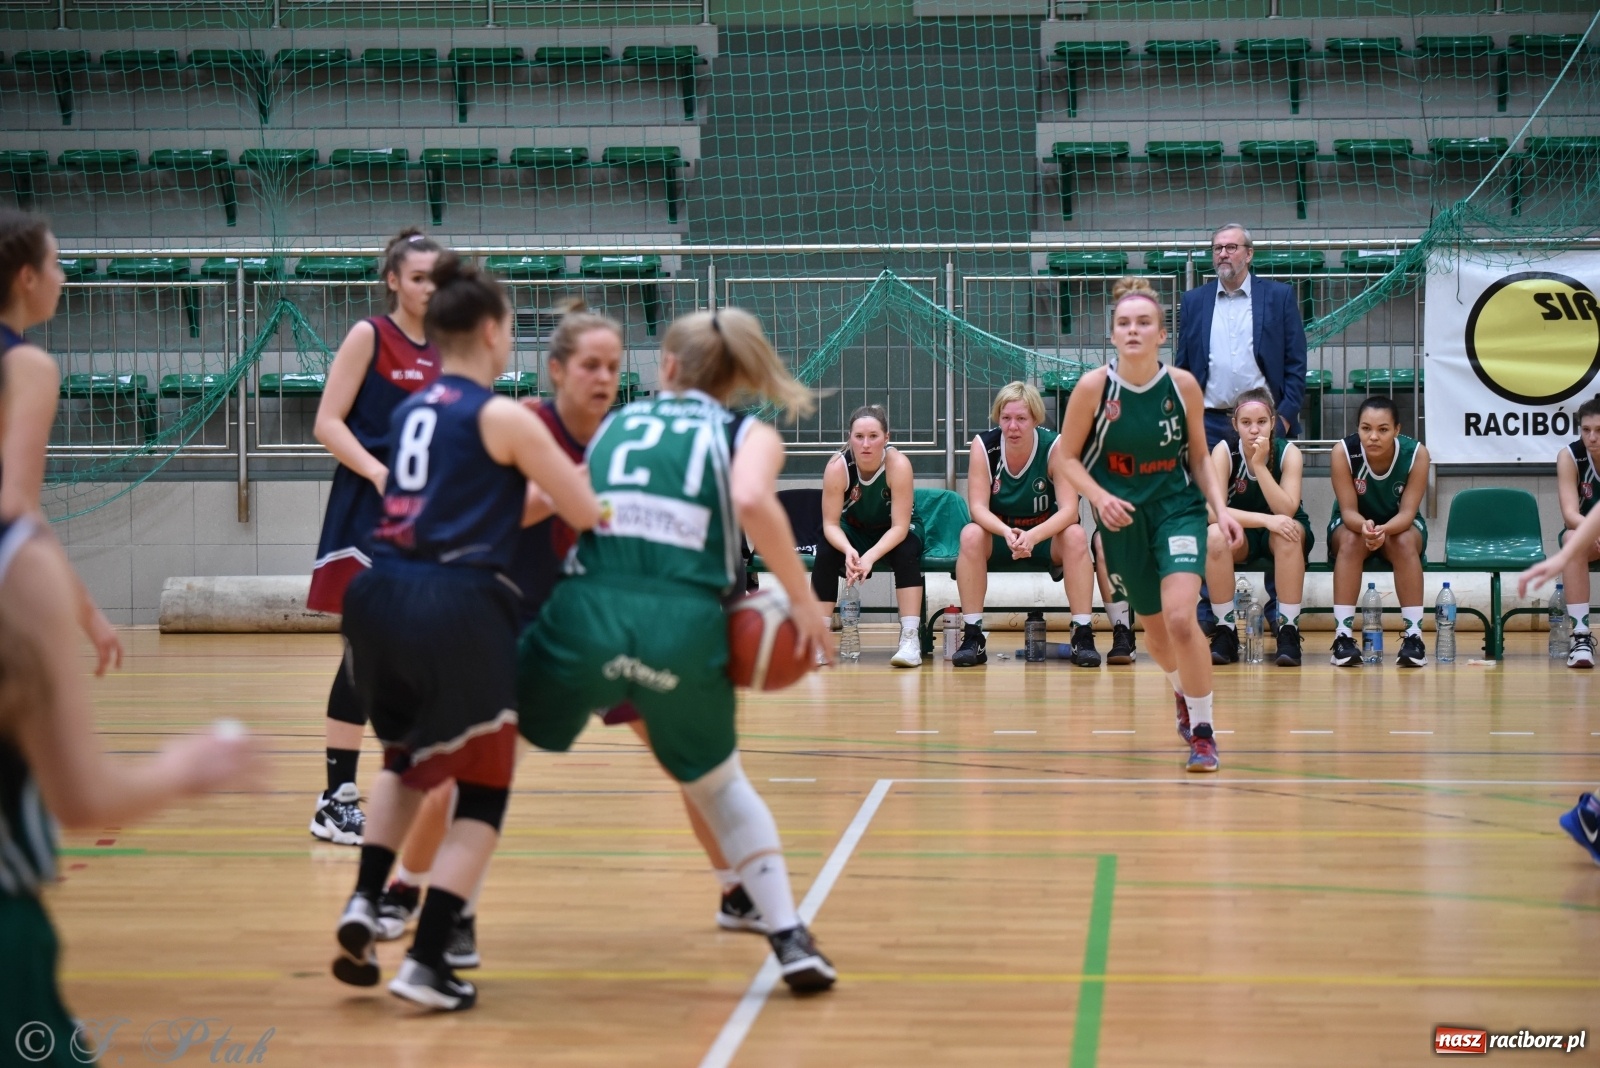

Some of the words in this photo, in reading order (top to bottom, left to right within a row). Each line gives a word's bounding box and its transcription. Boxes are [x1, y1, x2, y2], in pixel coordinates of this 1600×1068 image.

[395, 407, 437, 491] 8
[607, 415, 712, 497] 27
[1159, 415, 1182, 447] 35
[1033, 494, 1048, 513] 10
